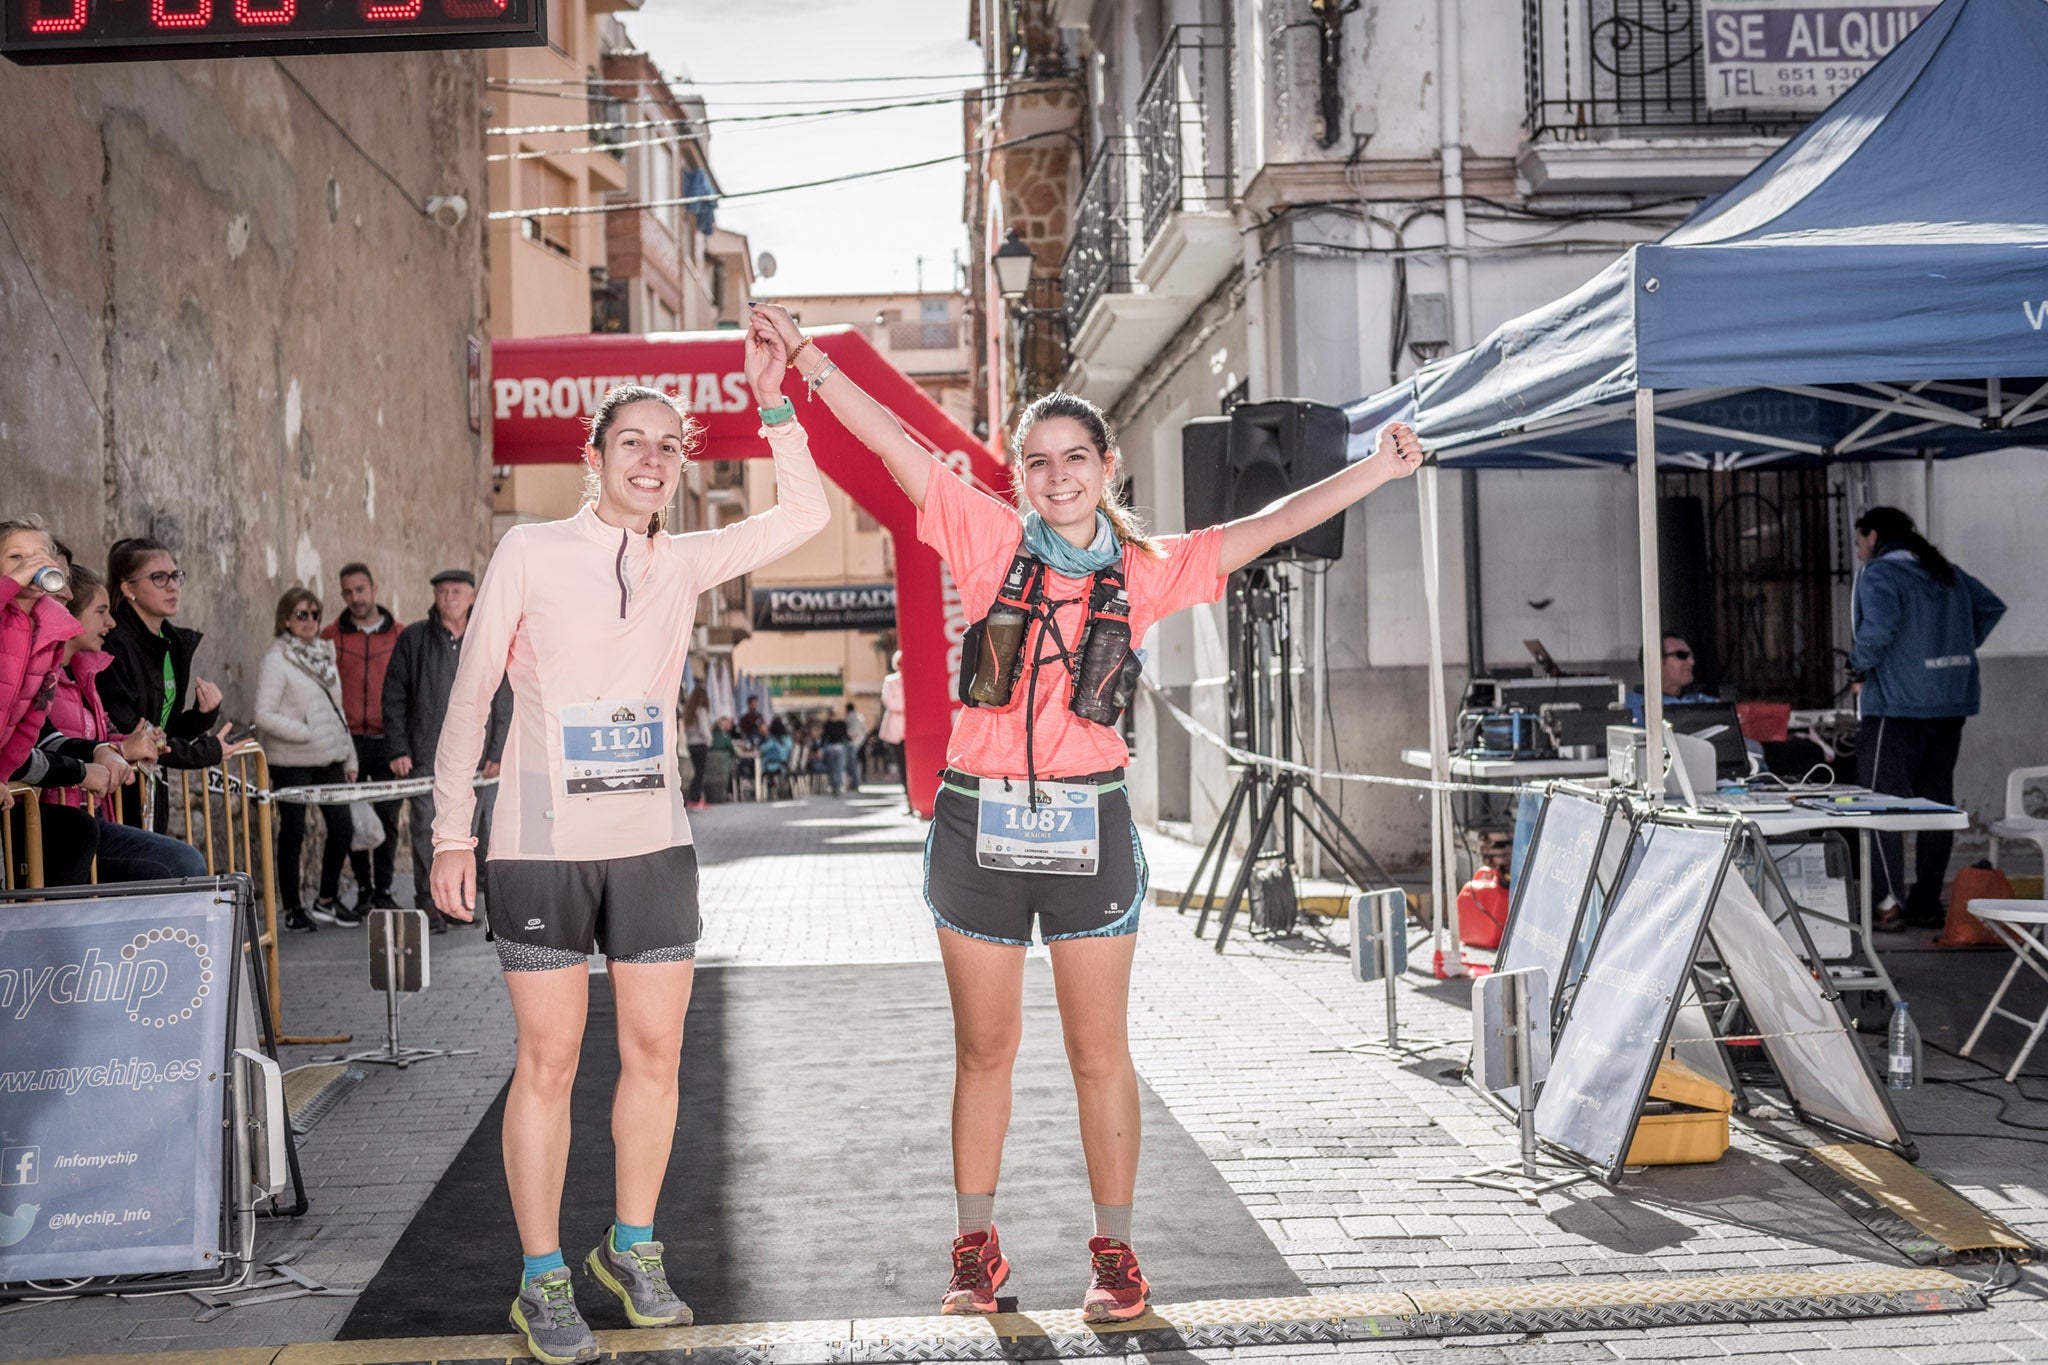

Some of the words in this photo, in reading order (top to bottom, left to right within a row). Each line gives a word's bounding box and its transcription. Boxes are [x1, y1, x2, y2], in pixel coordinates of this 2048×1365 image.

[1715, 13, 1766, 58] SE
[1778, 67, 1815, 81] 651
[1779, 84, 1818, 98] 964
[591, 726, 652, 752] 1120
[1005, 807, 1073, 832] 1087
[54, 1151, 138, 1168] /infomychip
[48, 1208, 151, 1230] @Mychip_Info
